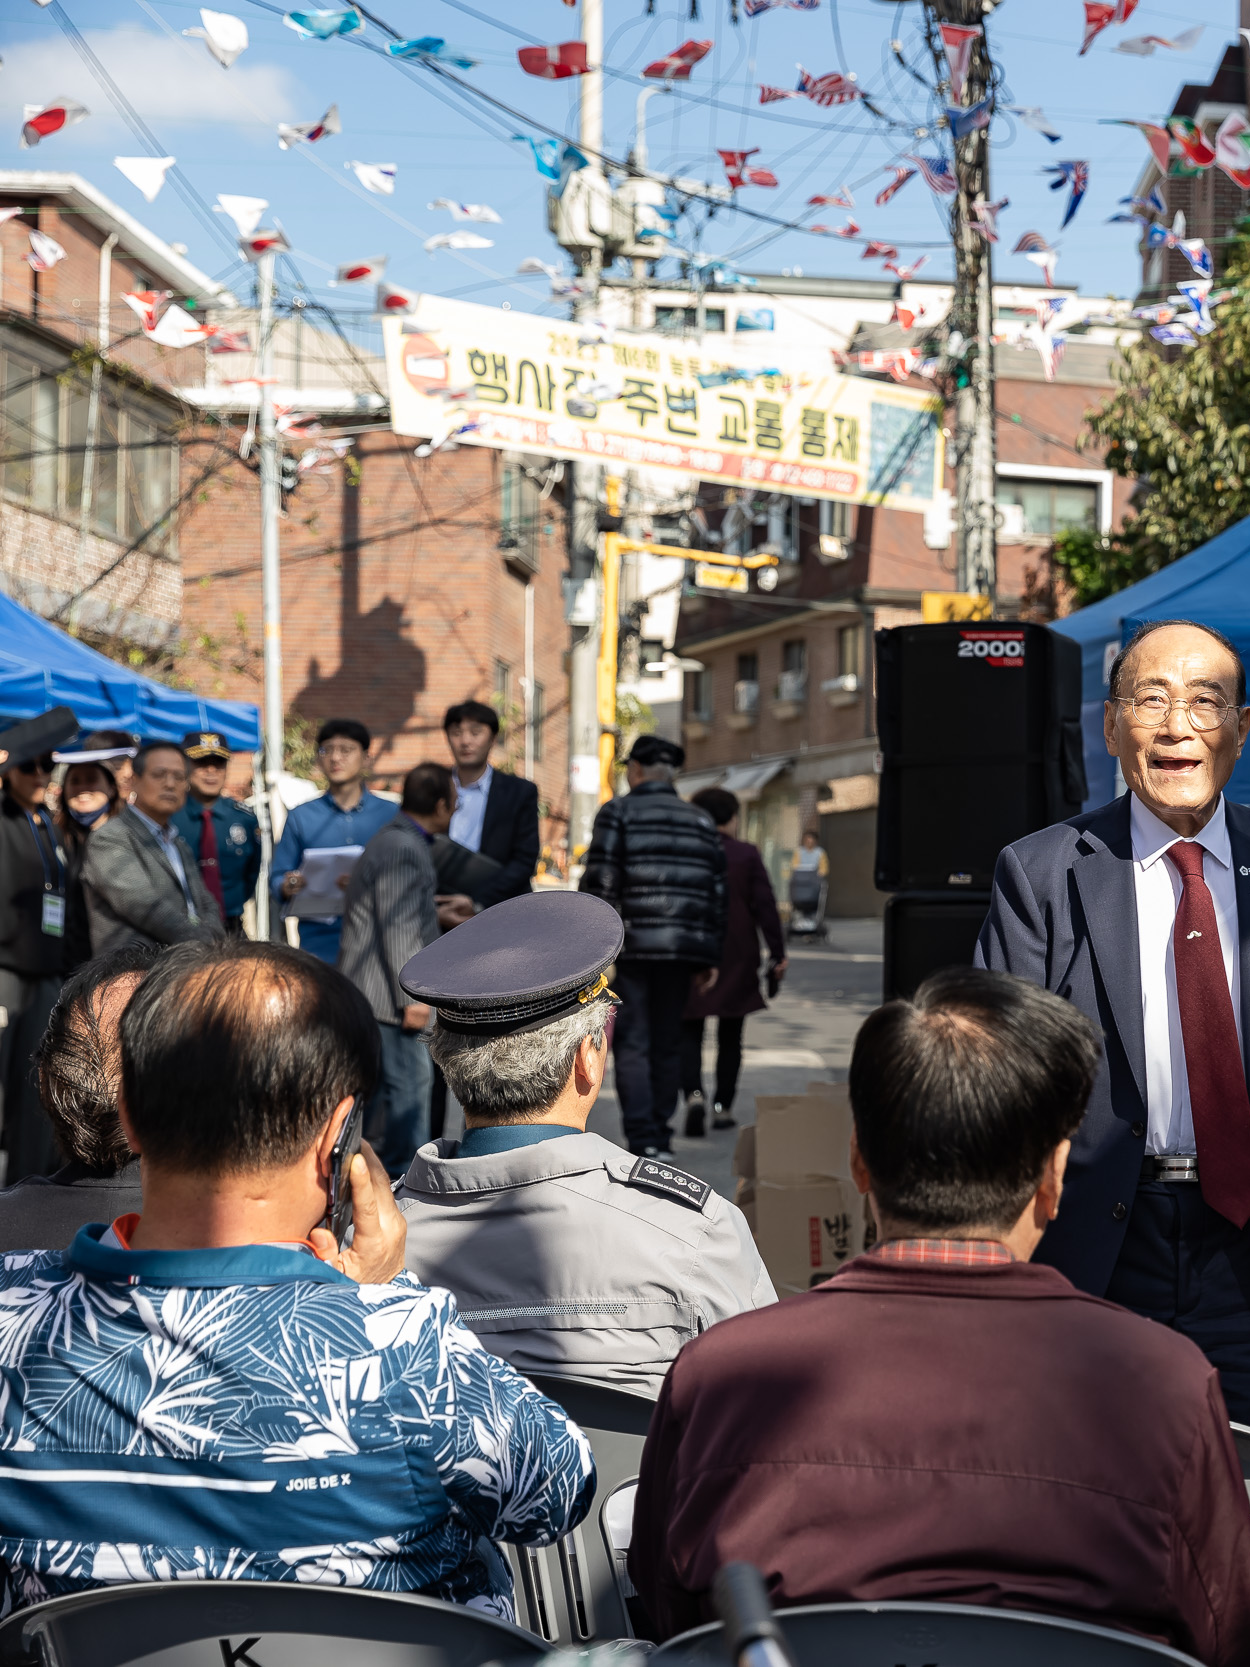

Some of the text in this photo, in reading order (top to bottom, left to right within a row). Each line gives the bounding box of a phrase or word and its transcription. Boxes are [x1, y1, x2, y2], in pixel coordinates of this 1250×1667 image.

[621, 378, 698, 437] 주변
[716, 394, 783, 451] 교통
[801, 407, 858, 463] 통제
[958, 640, 1020, 657] 2000
[285, 1472, 352, 1492] JOIE DE X
[218, 1636, 263, 1667] K
